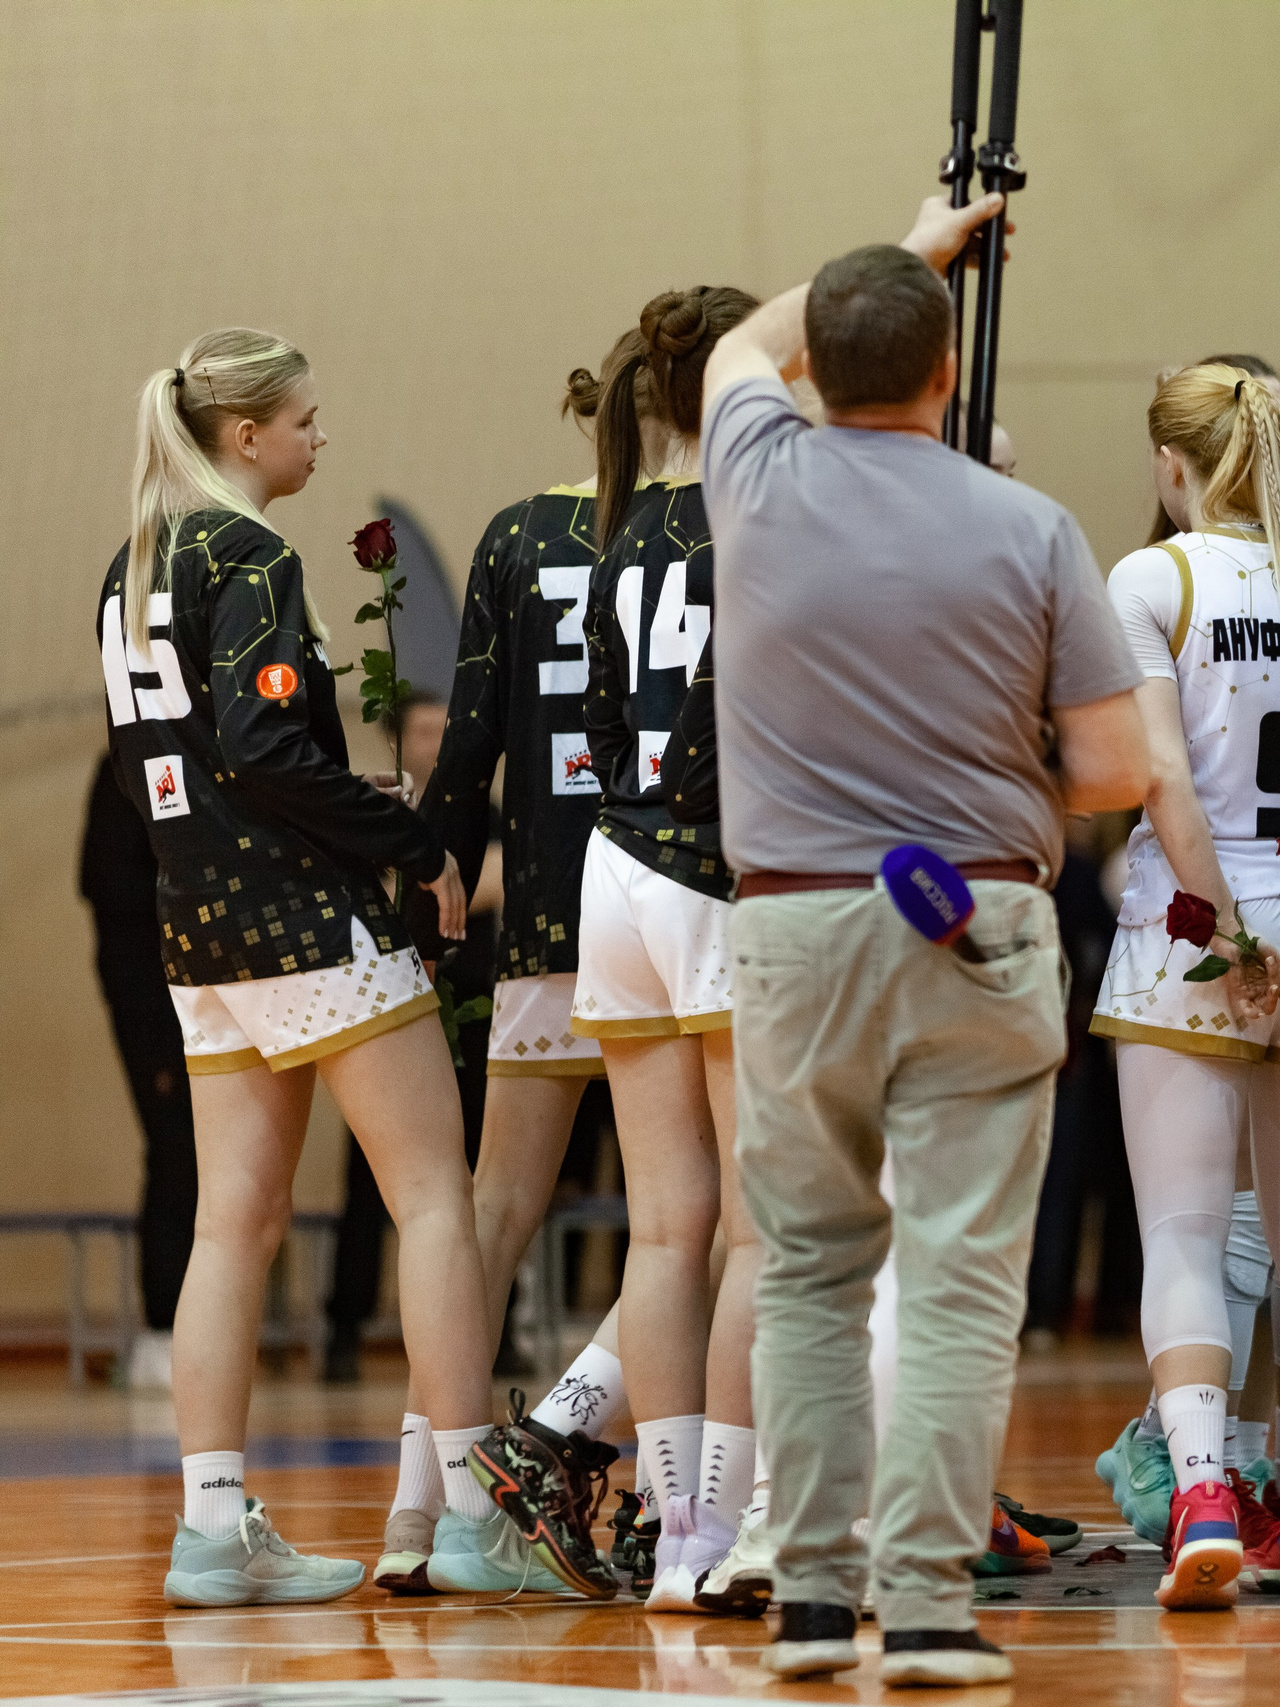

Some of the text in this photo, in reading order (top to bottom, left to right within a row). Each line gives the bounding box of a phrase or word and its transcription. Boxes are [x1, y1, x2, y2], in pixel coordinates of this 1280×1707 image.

[101, 592, 192, 727] 15
[615, 560, 711, 695] 14
[201, 1477, 244, 1489] adida
